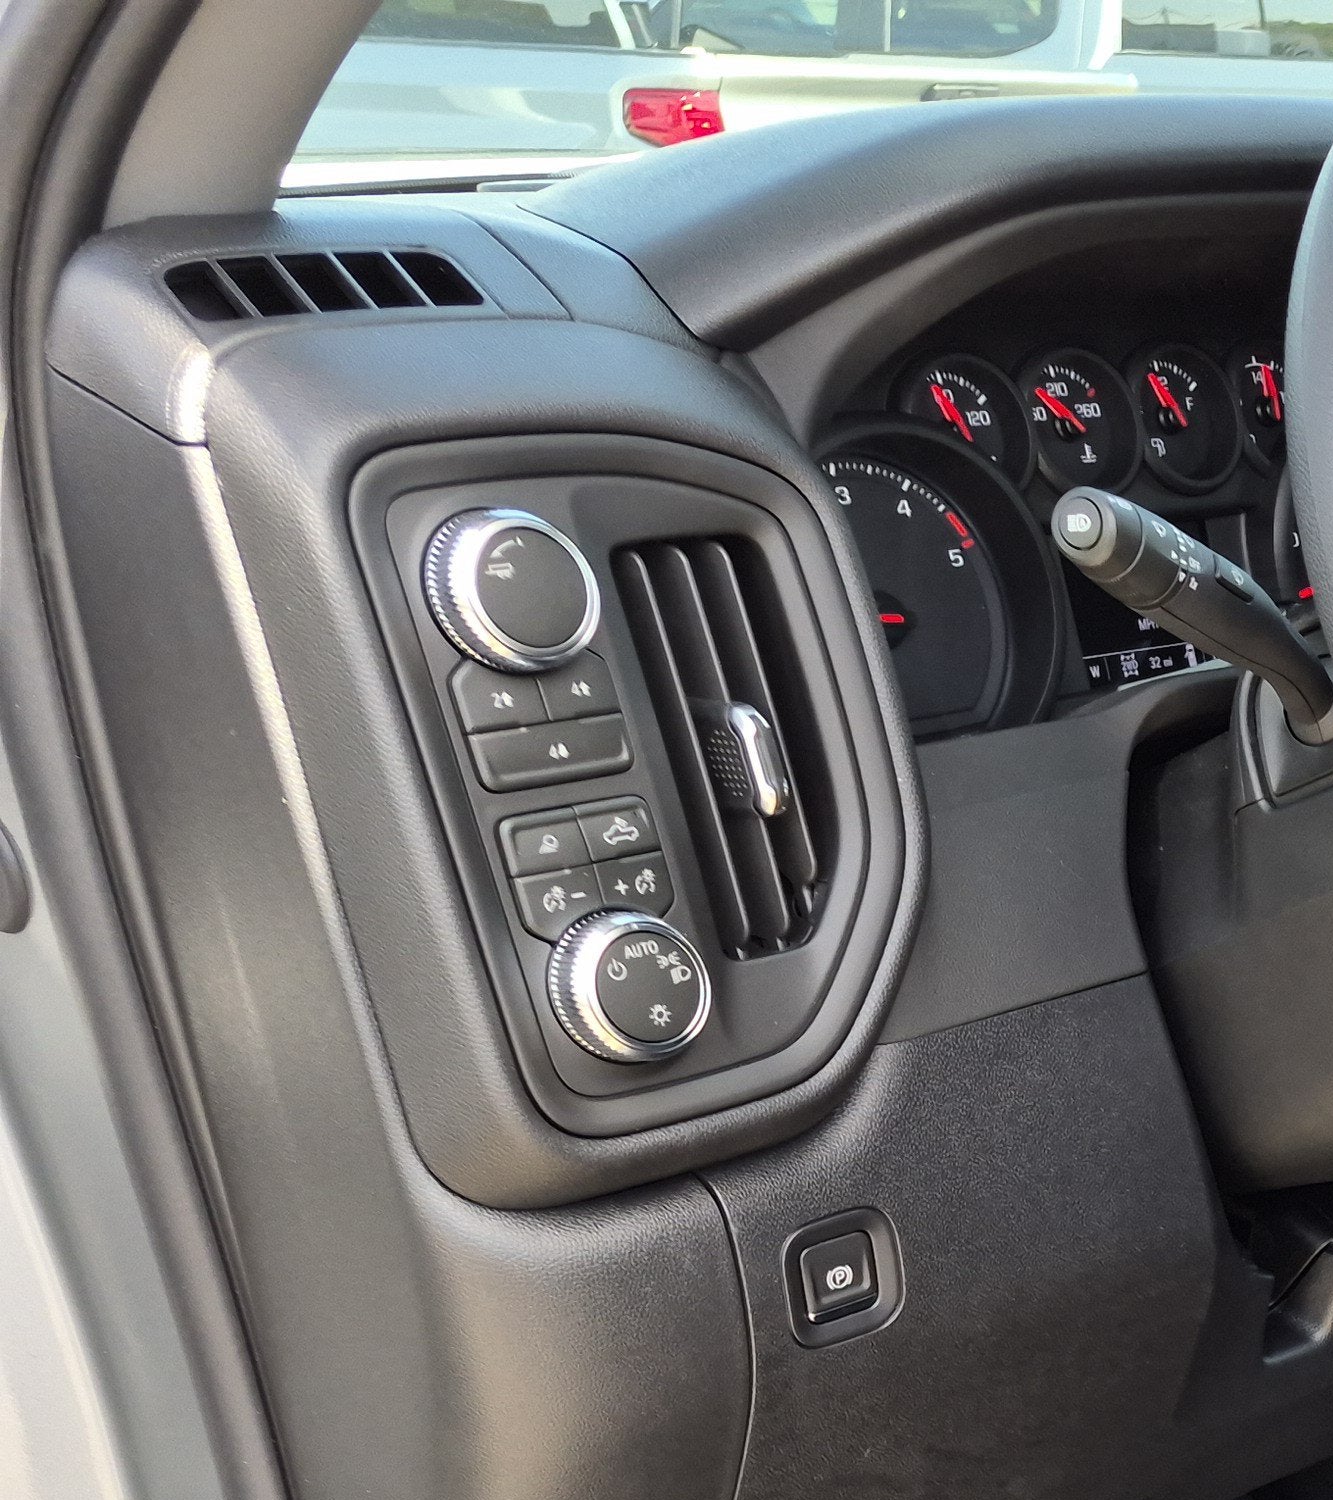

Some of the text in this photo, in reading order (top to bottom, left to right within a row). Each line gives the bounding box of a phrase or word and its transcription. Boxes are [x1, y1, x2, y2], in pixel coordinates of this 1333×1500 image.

[1046, 382, 1068, 397] 210
[1074, 403, 1101, 418] 260
[1185, 396, 1194, 411] F
[966, 410, 991, 426] 120
[834, 485, 852, 506] 3
[897, 499, 912, 518] 4
[948, 549, 965, 568] 5
[1149, 656, 1162, 670] 32
[1089, 665, 1101, 678] W
[624, 939, 659, 960] AUTO
